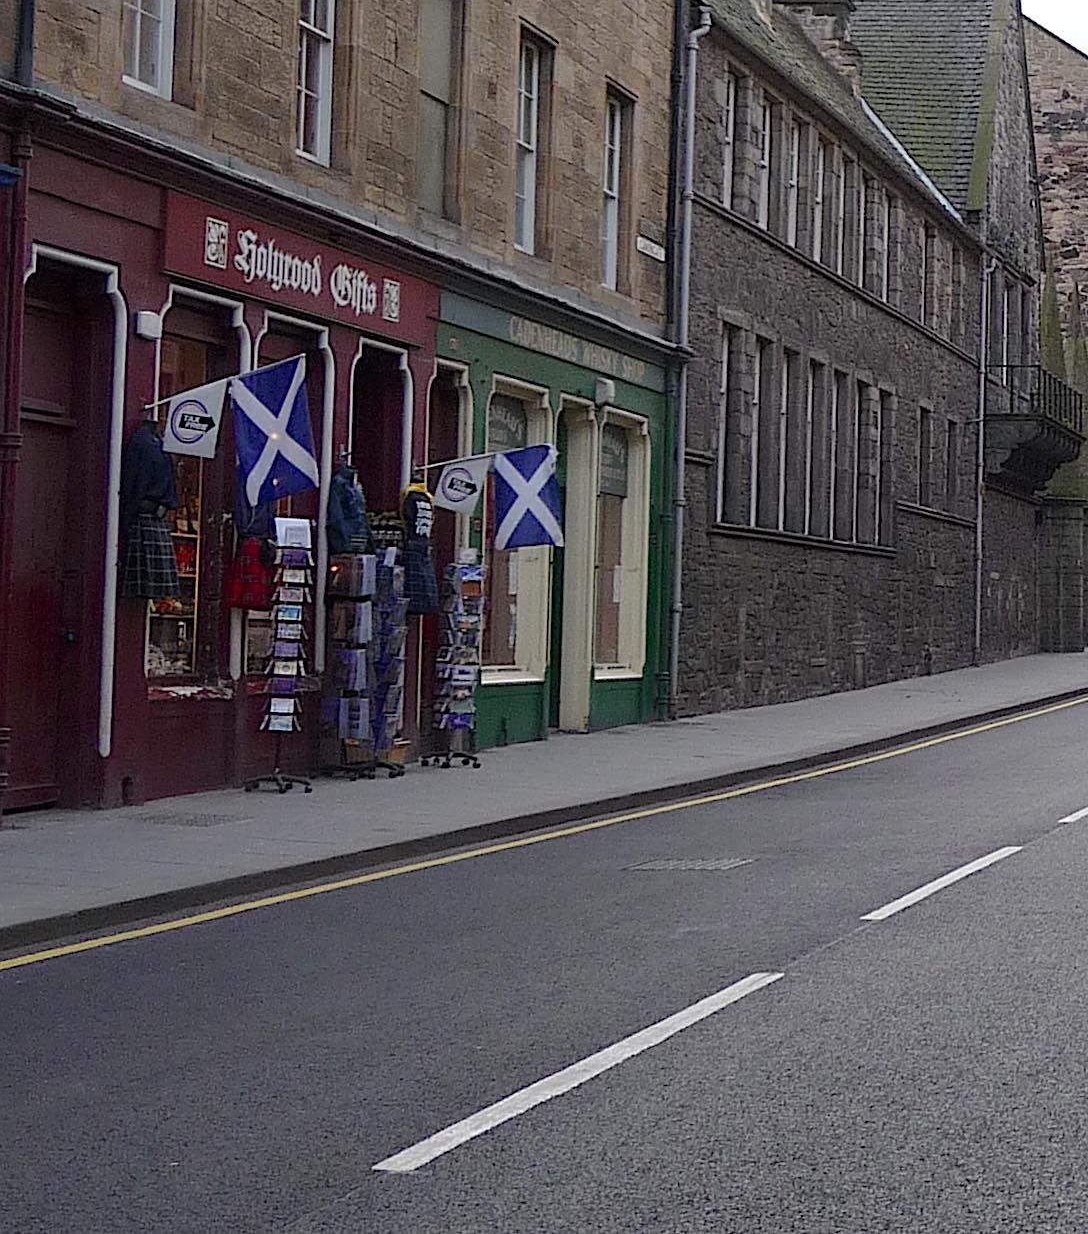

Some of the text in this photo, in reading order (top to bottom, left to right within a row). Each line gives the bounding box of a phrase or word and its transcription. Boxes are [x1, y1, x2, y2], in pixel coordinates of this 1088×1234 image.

[234, 229, 321, 296] Holyrood
[330, 264, 378, 316] Gifts
[184, 415, 201, 423] TAX
